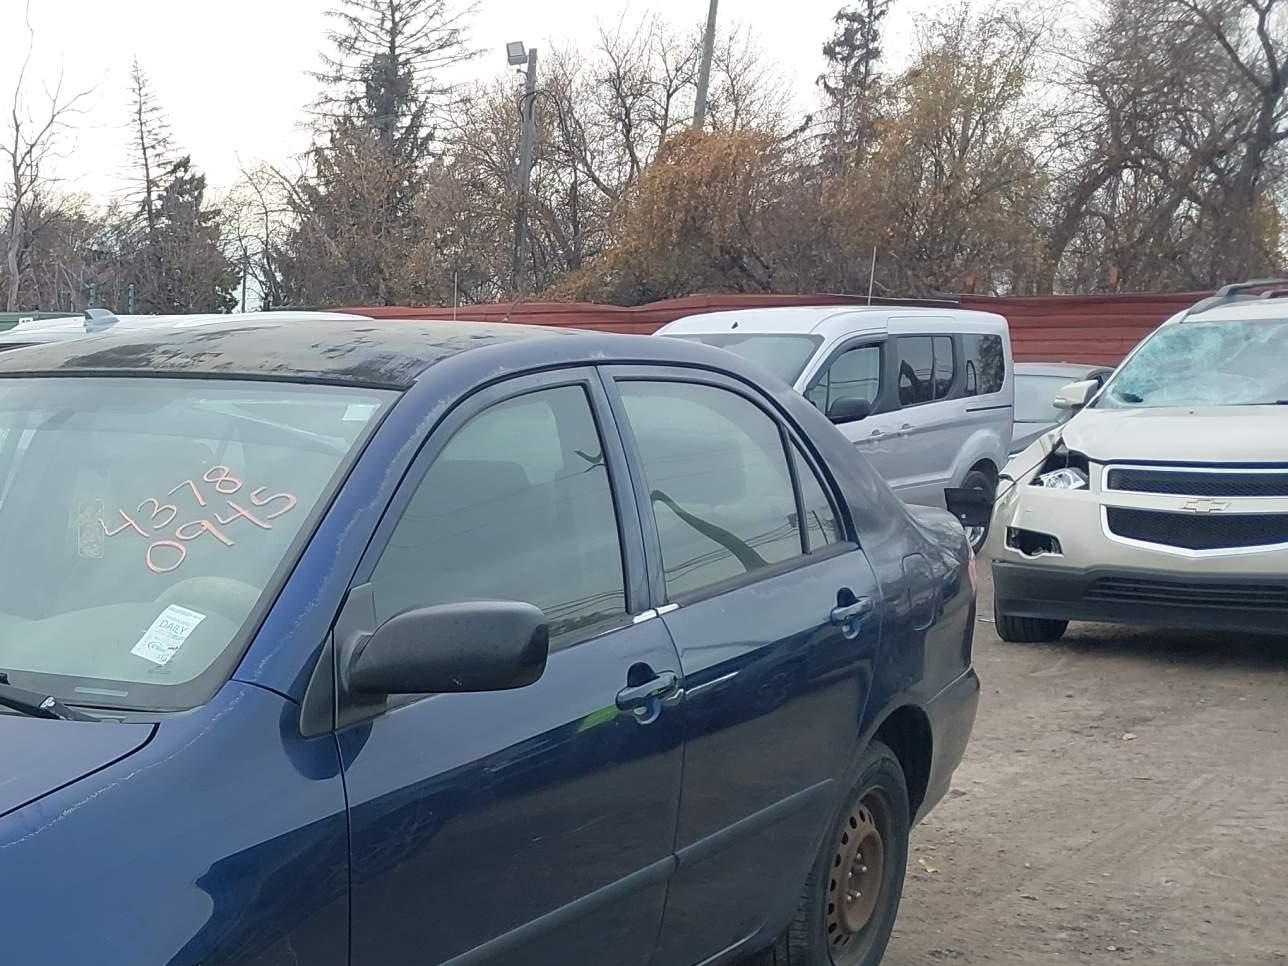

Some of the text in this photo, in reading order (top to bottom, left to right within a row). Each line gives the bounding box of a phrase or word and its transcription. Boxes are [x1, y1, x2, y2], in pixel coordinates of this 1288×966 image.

[97, 465, 243, 539] 4378
[145, 485, 298, 574] 0945
[158, 618, 188, 635] DAILY
